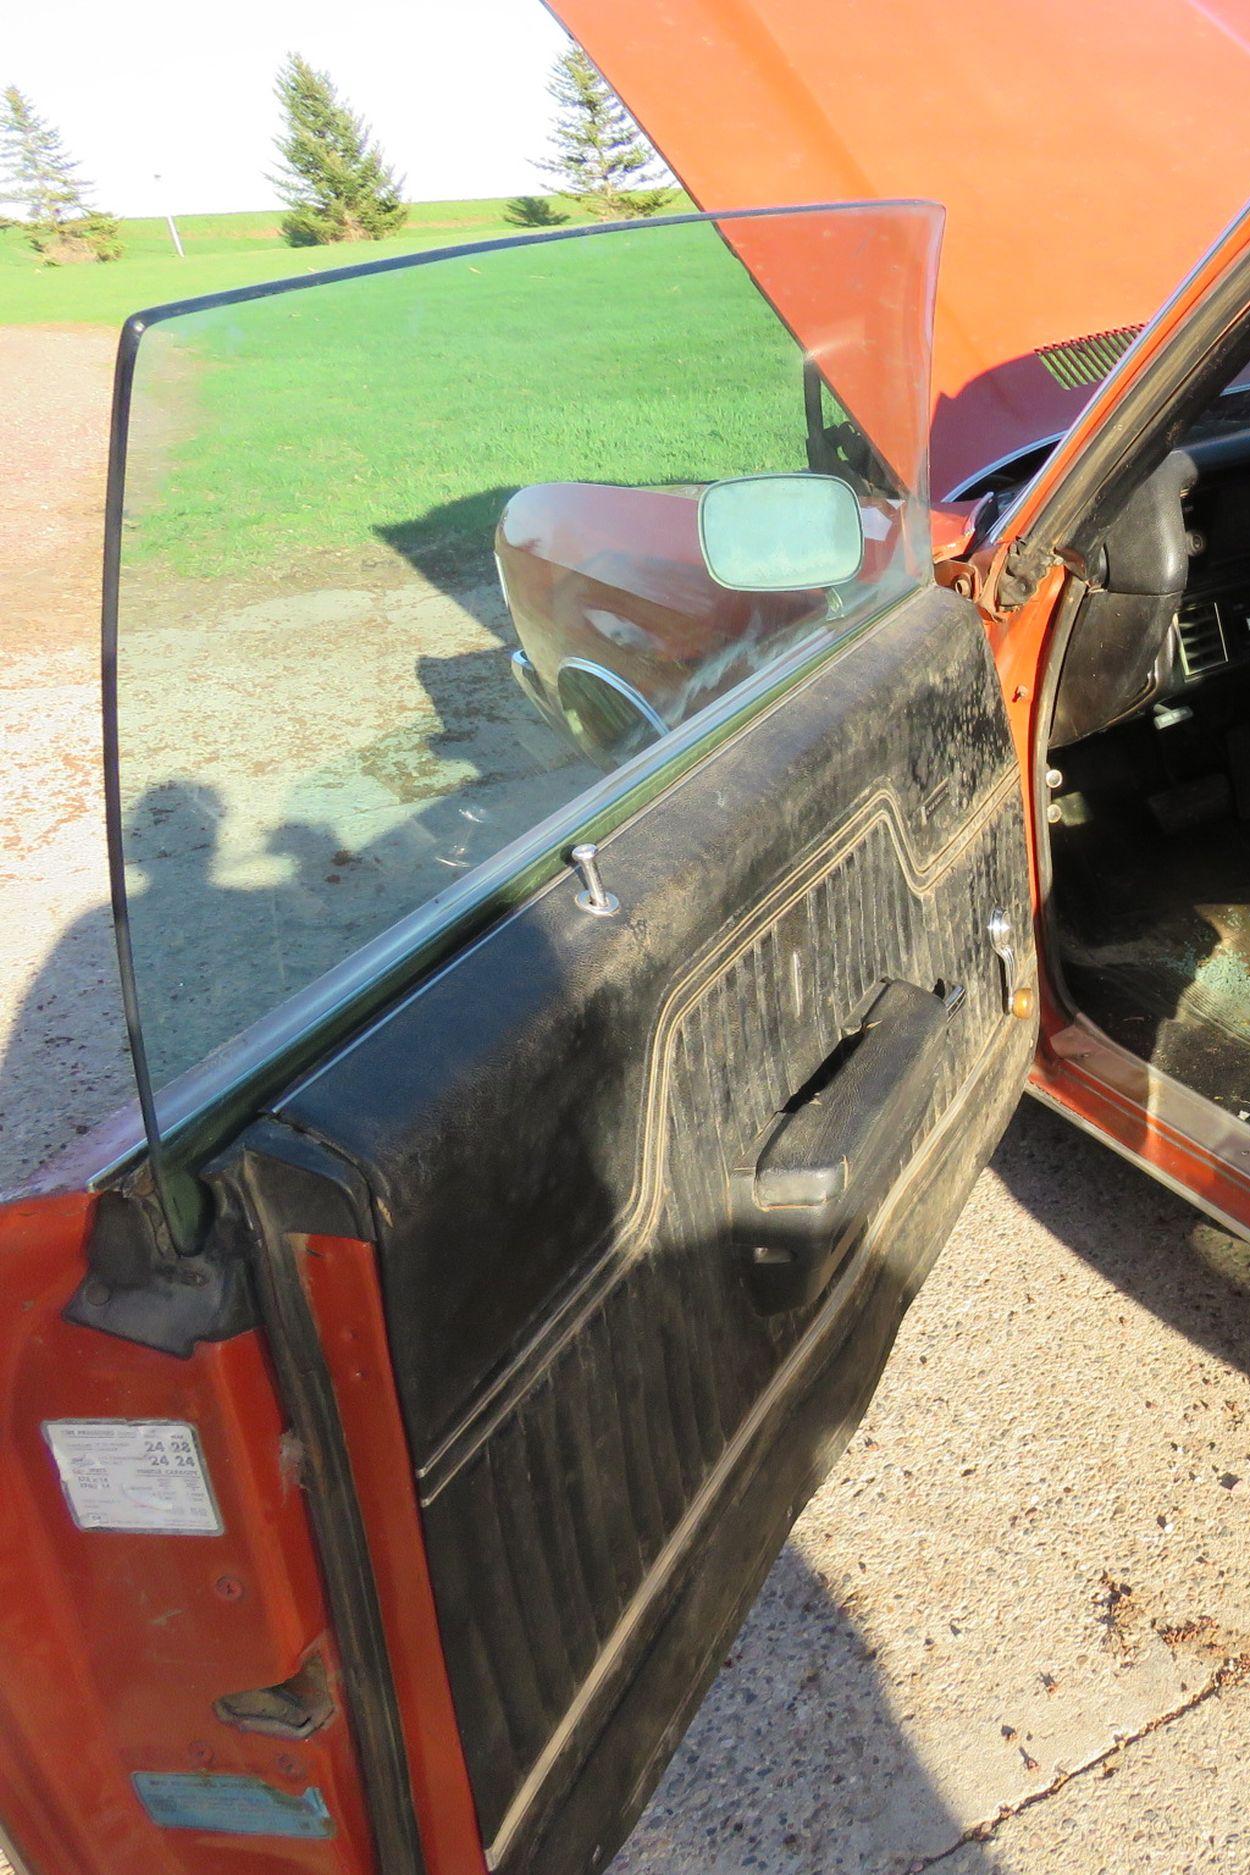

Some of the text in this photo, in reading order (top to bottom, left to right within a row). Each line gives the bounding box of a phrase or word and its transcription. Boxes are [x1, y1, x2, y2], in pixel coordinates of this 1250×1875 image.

[144, 1441, 191, 1453] 24 28
[149, 1455, 169, 1466] 24
[175, 1455, 195, 1467] 24
